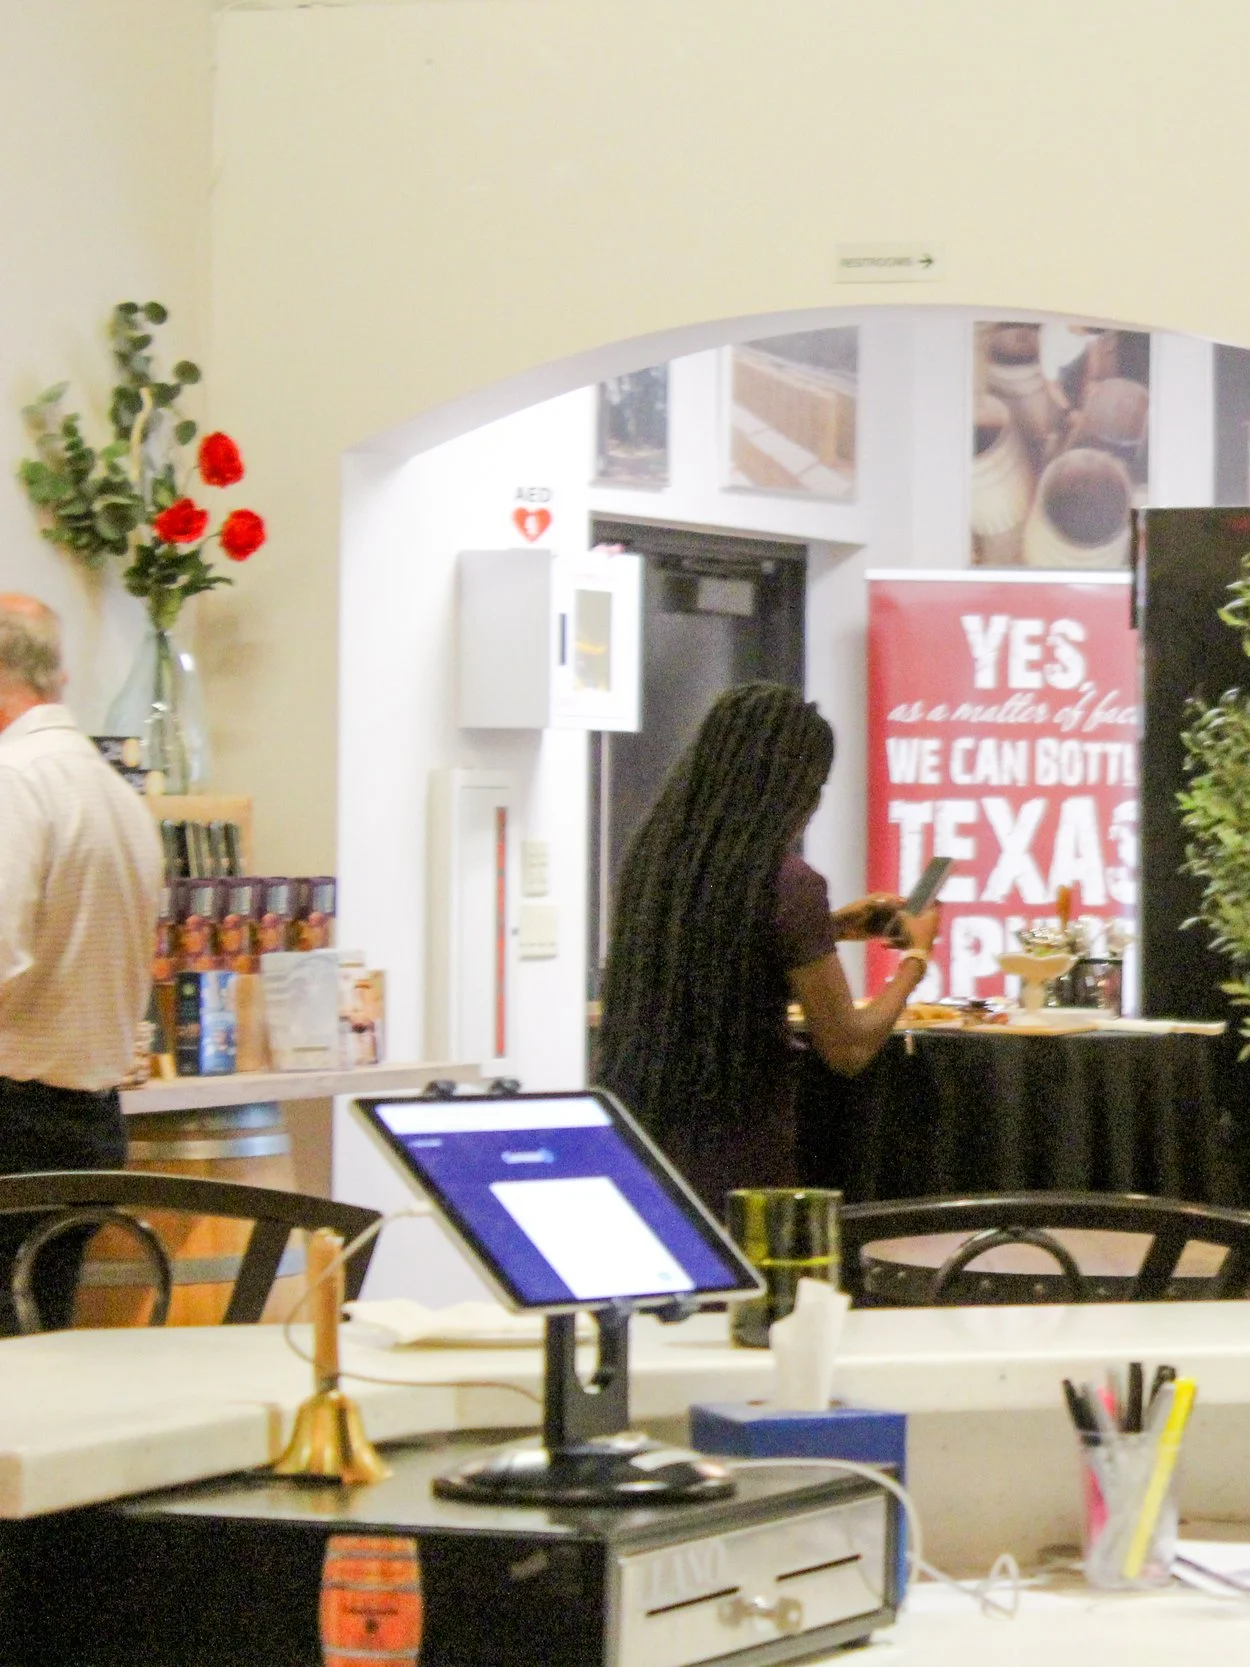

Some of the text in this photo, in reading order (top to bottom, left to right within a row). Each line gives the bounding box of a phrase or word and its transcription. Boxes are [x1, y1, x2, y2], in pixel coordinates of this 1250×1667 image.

[514, 486, 552, 502] AED
[960, 615, 1095, 692] YES,
[887, 700, 923, 723] as
[926, 703, 949, 722] a
[951, 691, 1048, 724] matter
[1052, 690, 1097, 733] of
[886, 737, 1137, 787] WE CAN BOTTL
